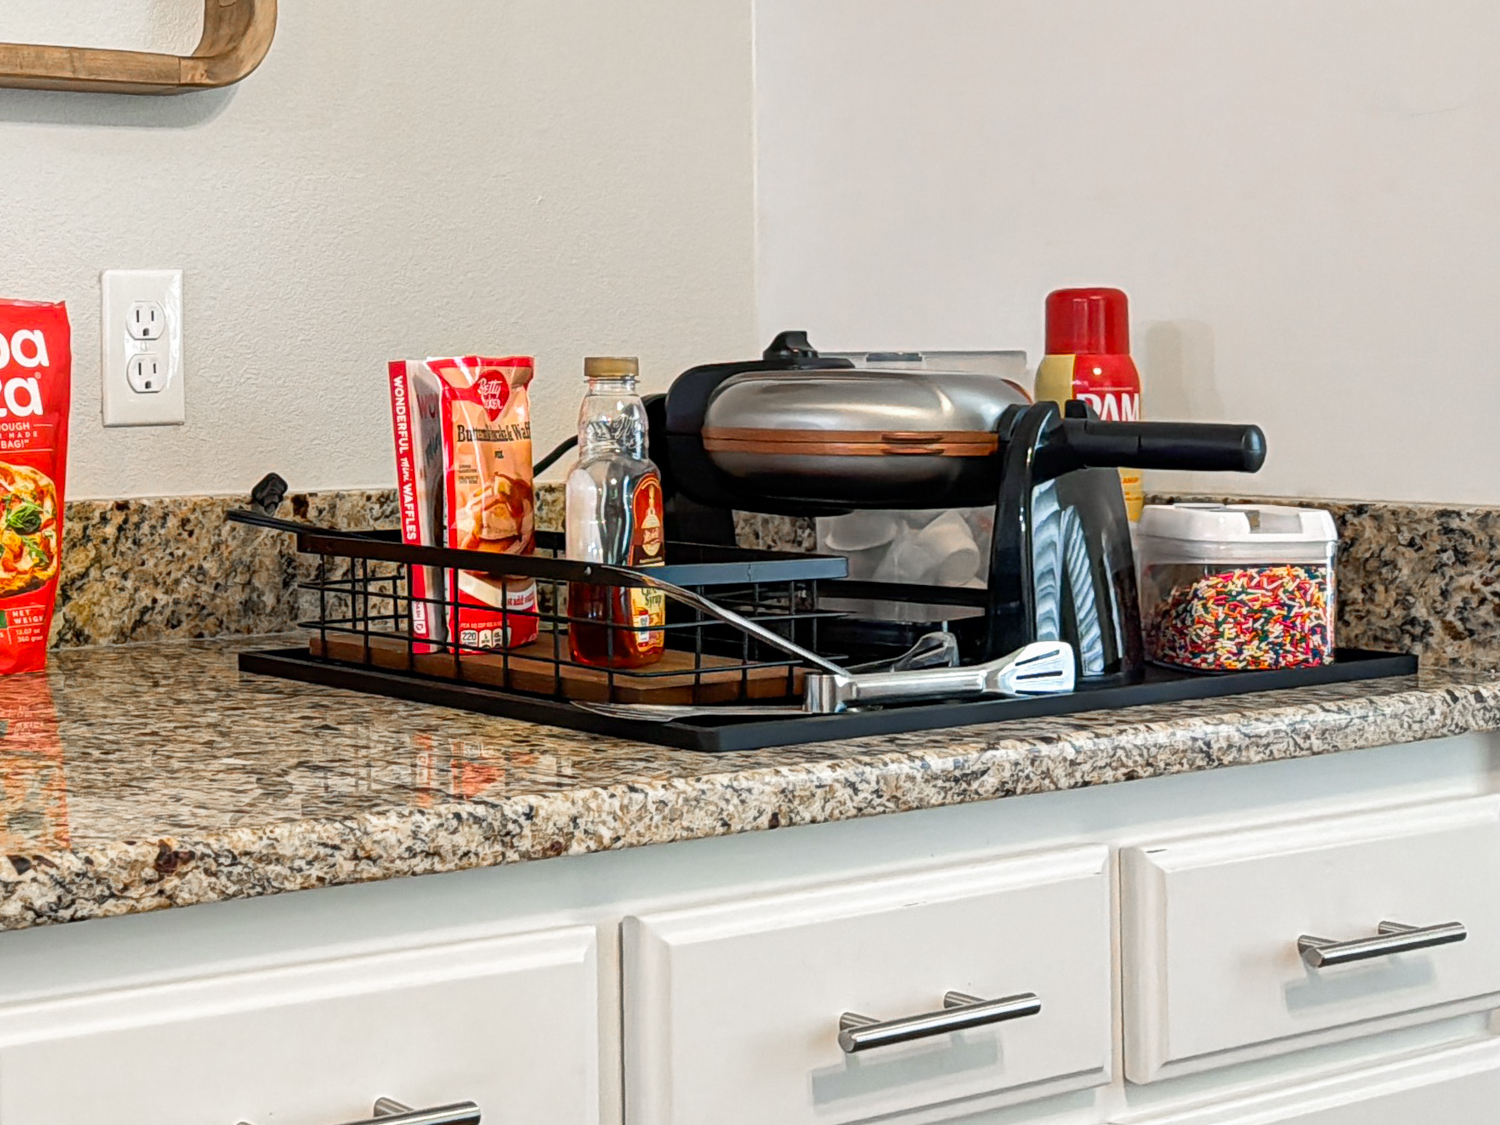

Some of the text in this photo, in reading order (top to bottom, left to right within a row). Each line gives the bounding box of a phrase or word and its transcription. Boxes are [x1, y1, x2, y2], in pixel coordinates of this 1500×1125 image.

[393, 375, 410, 454] WONDERFUL
[1076, 393, 1140, 422] PAM
[8, 431, 38, 439] MADE
[400, 457, 412, 482] mini
[403, 483, 417, 541] WAFFLES
[12, 609, 30, 617] NET
